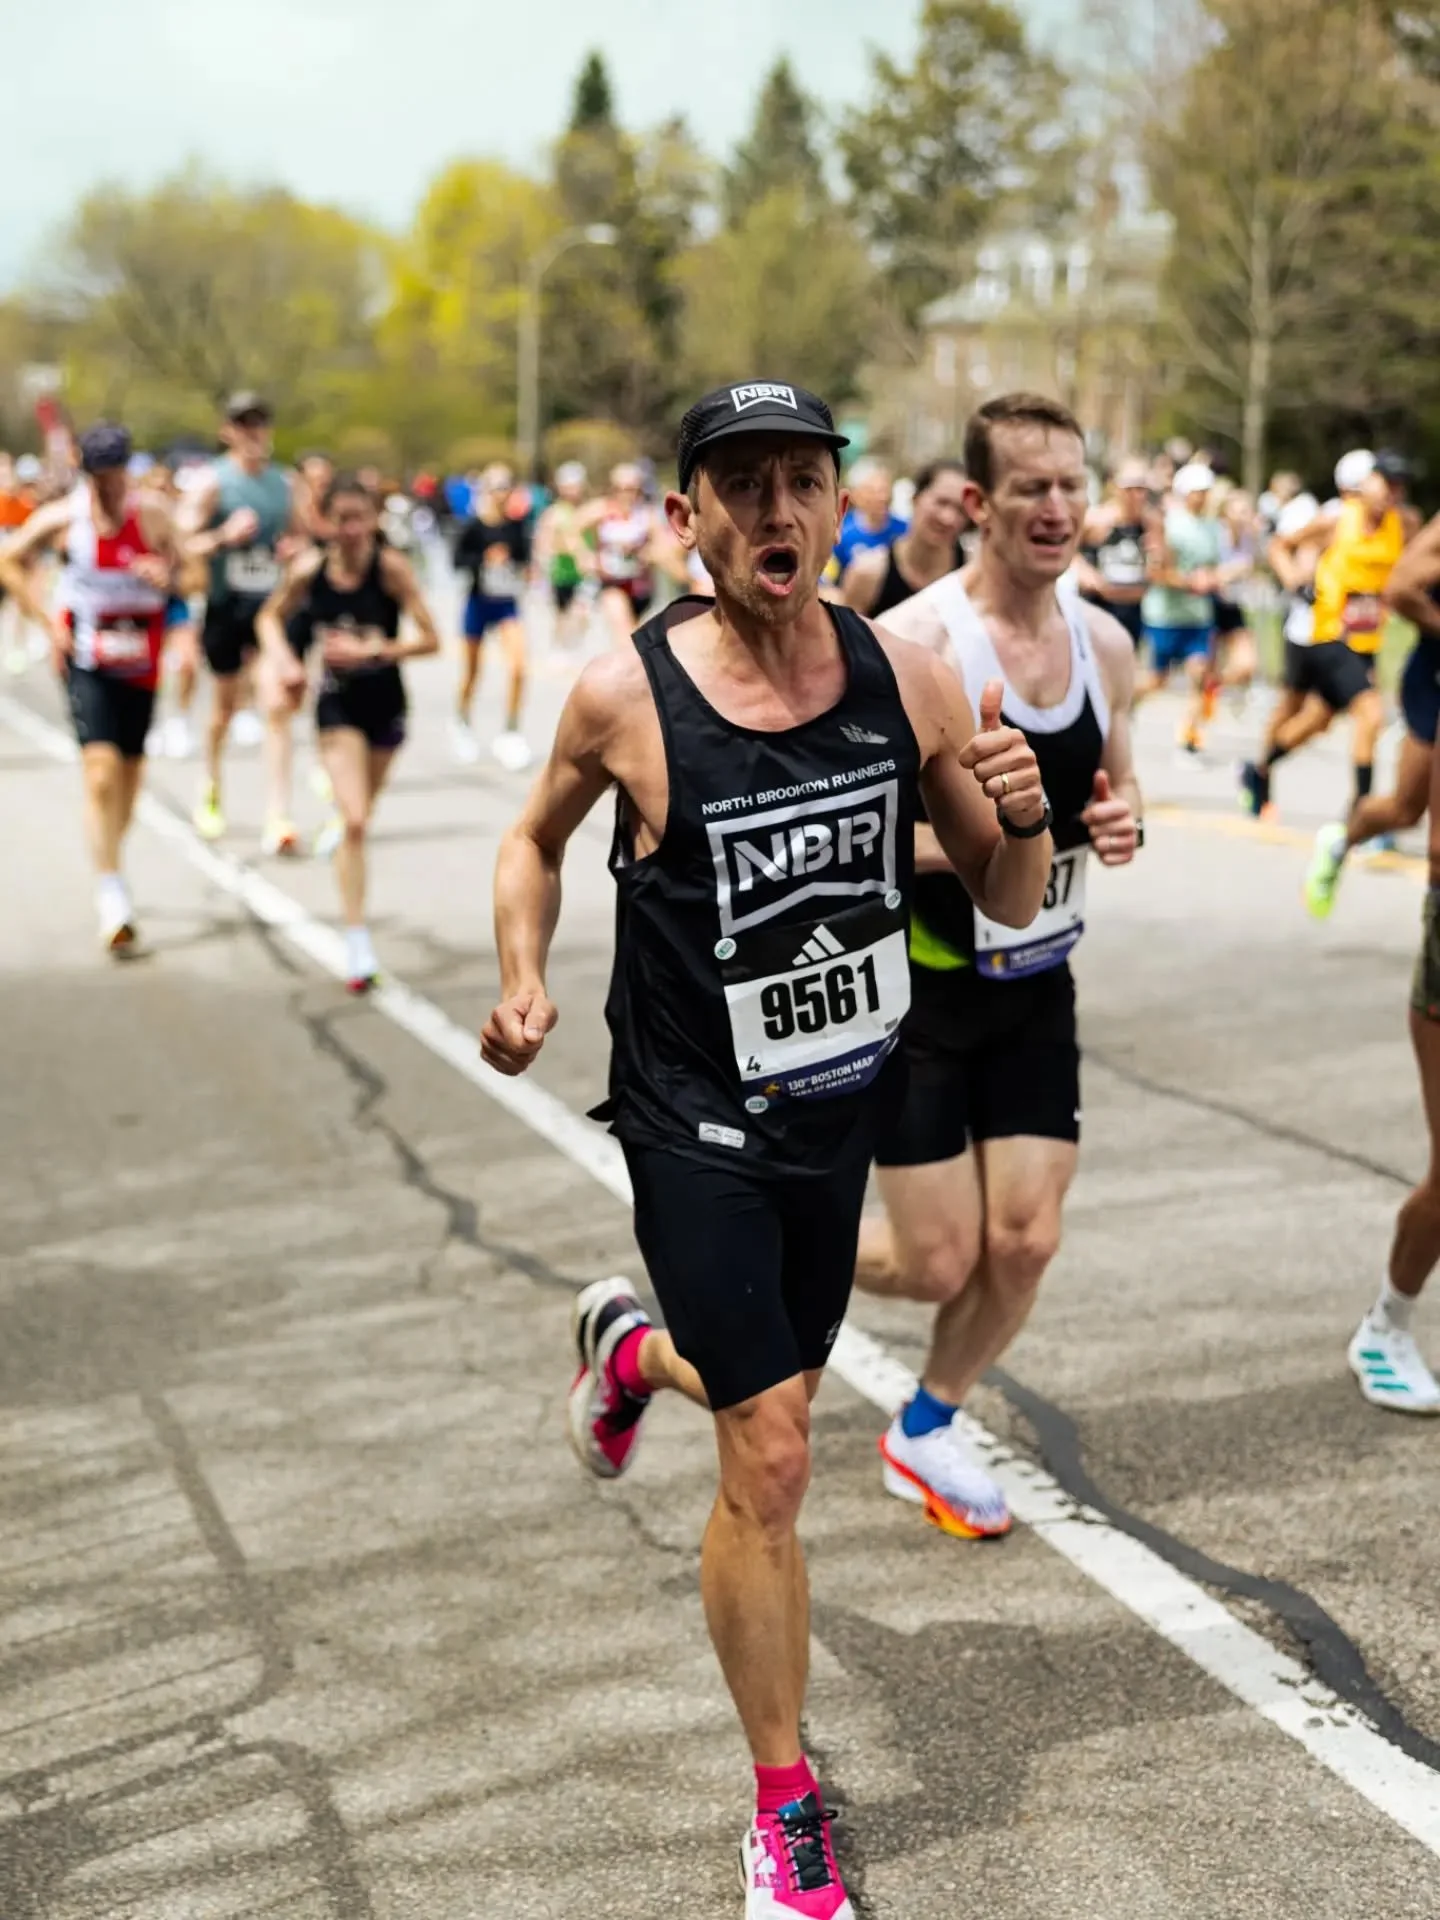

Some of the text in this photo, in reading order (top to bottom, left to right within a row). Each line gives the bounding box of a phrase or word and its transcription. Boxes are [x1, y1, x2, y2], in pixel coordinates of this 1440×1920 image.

[738, 387, 789, 401] NBR
[702, 758, 897, 816] NORTH BROOKLYN RUNNERS
[733, 811, 881, 891] NBR
[760, 954, 881, 1041] 9561
[746, 1056, 762, 1073] 4
[811, 1063, 852, 1085] BOSTON
[825, 1073, 861, 1089] AMERICA
